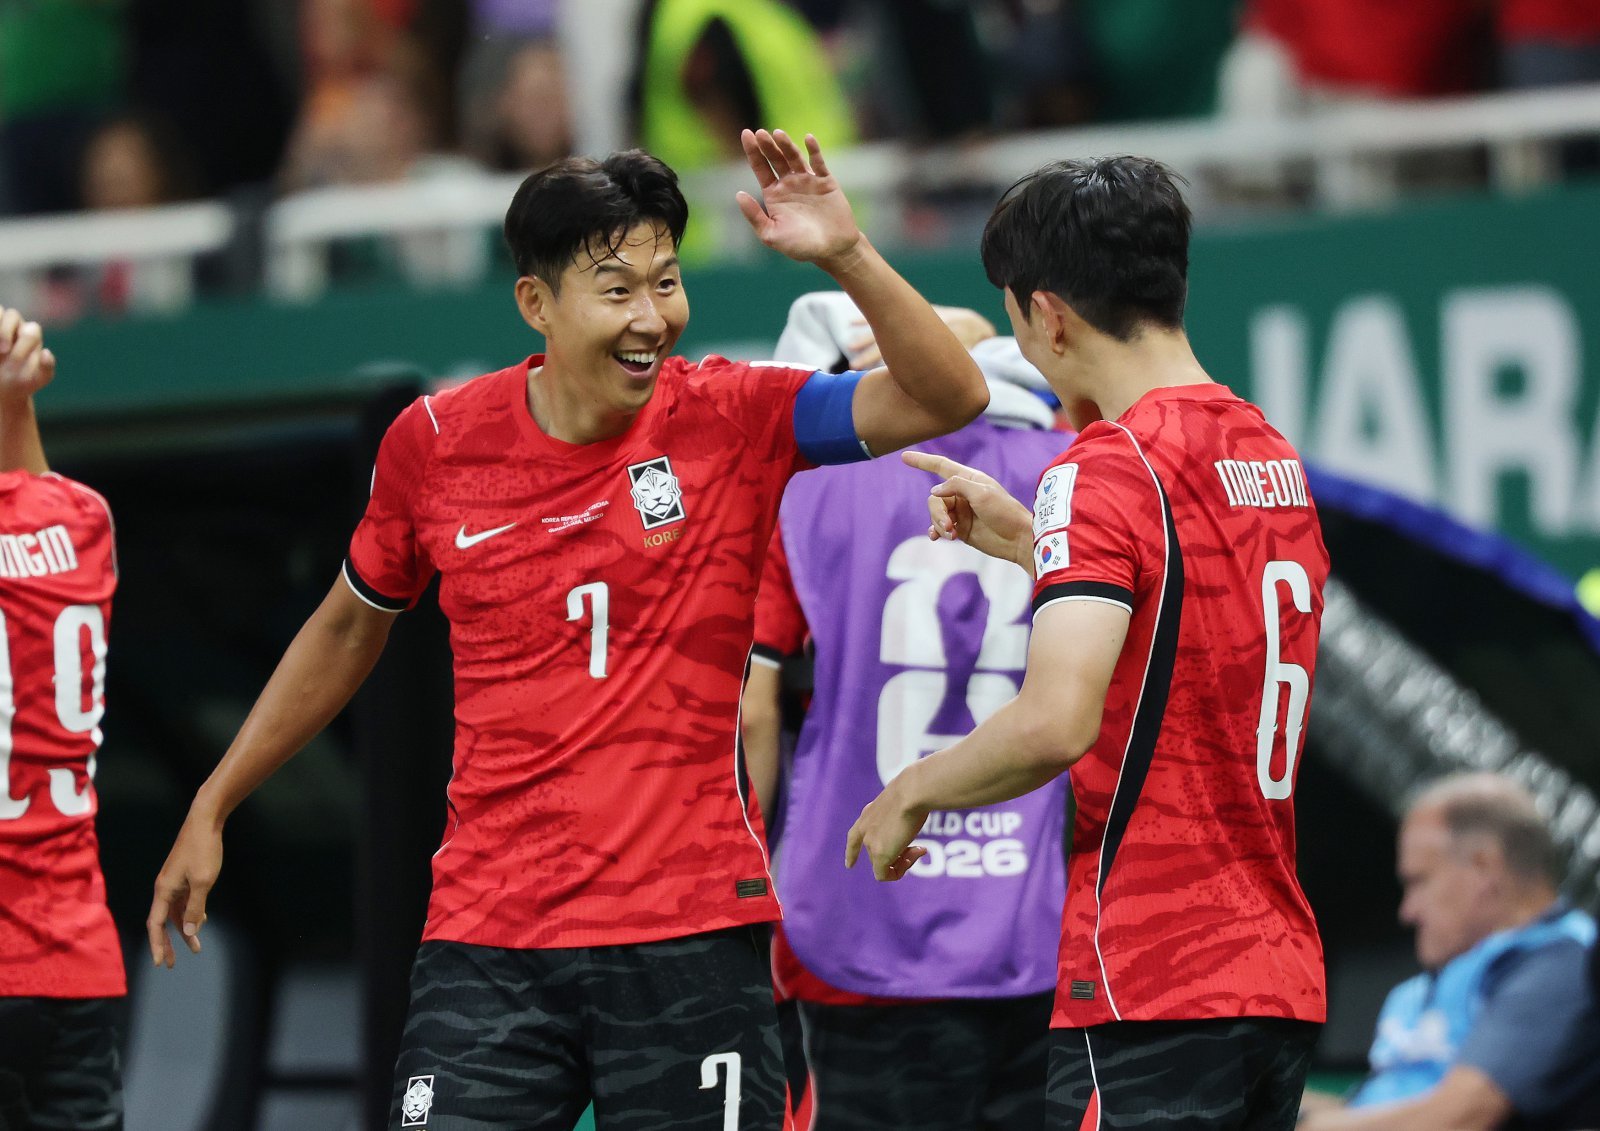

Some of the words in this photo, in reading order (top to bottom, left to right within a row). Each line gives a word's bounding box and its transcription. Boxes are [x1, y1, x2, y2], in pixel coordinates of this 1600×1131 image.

[1214, 459, 1309, 507] INBEOM
[643, 528, 682, 548] KORE
[566, 581, 609, 679] 7
[1257, 560, 1313, 801] 6
[964, 811, 1022, 837] CUP
[906, 837, 1029, 878] 026
[699, 1051, 742, 1131] 7
